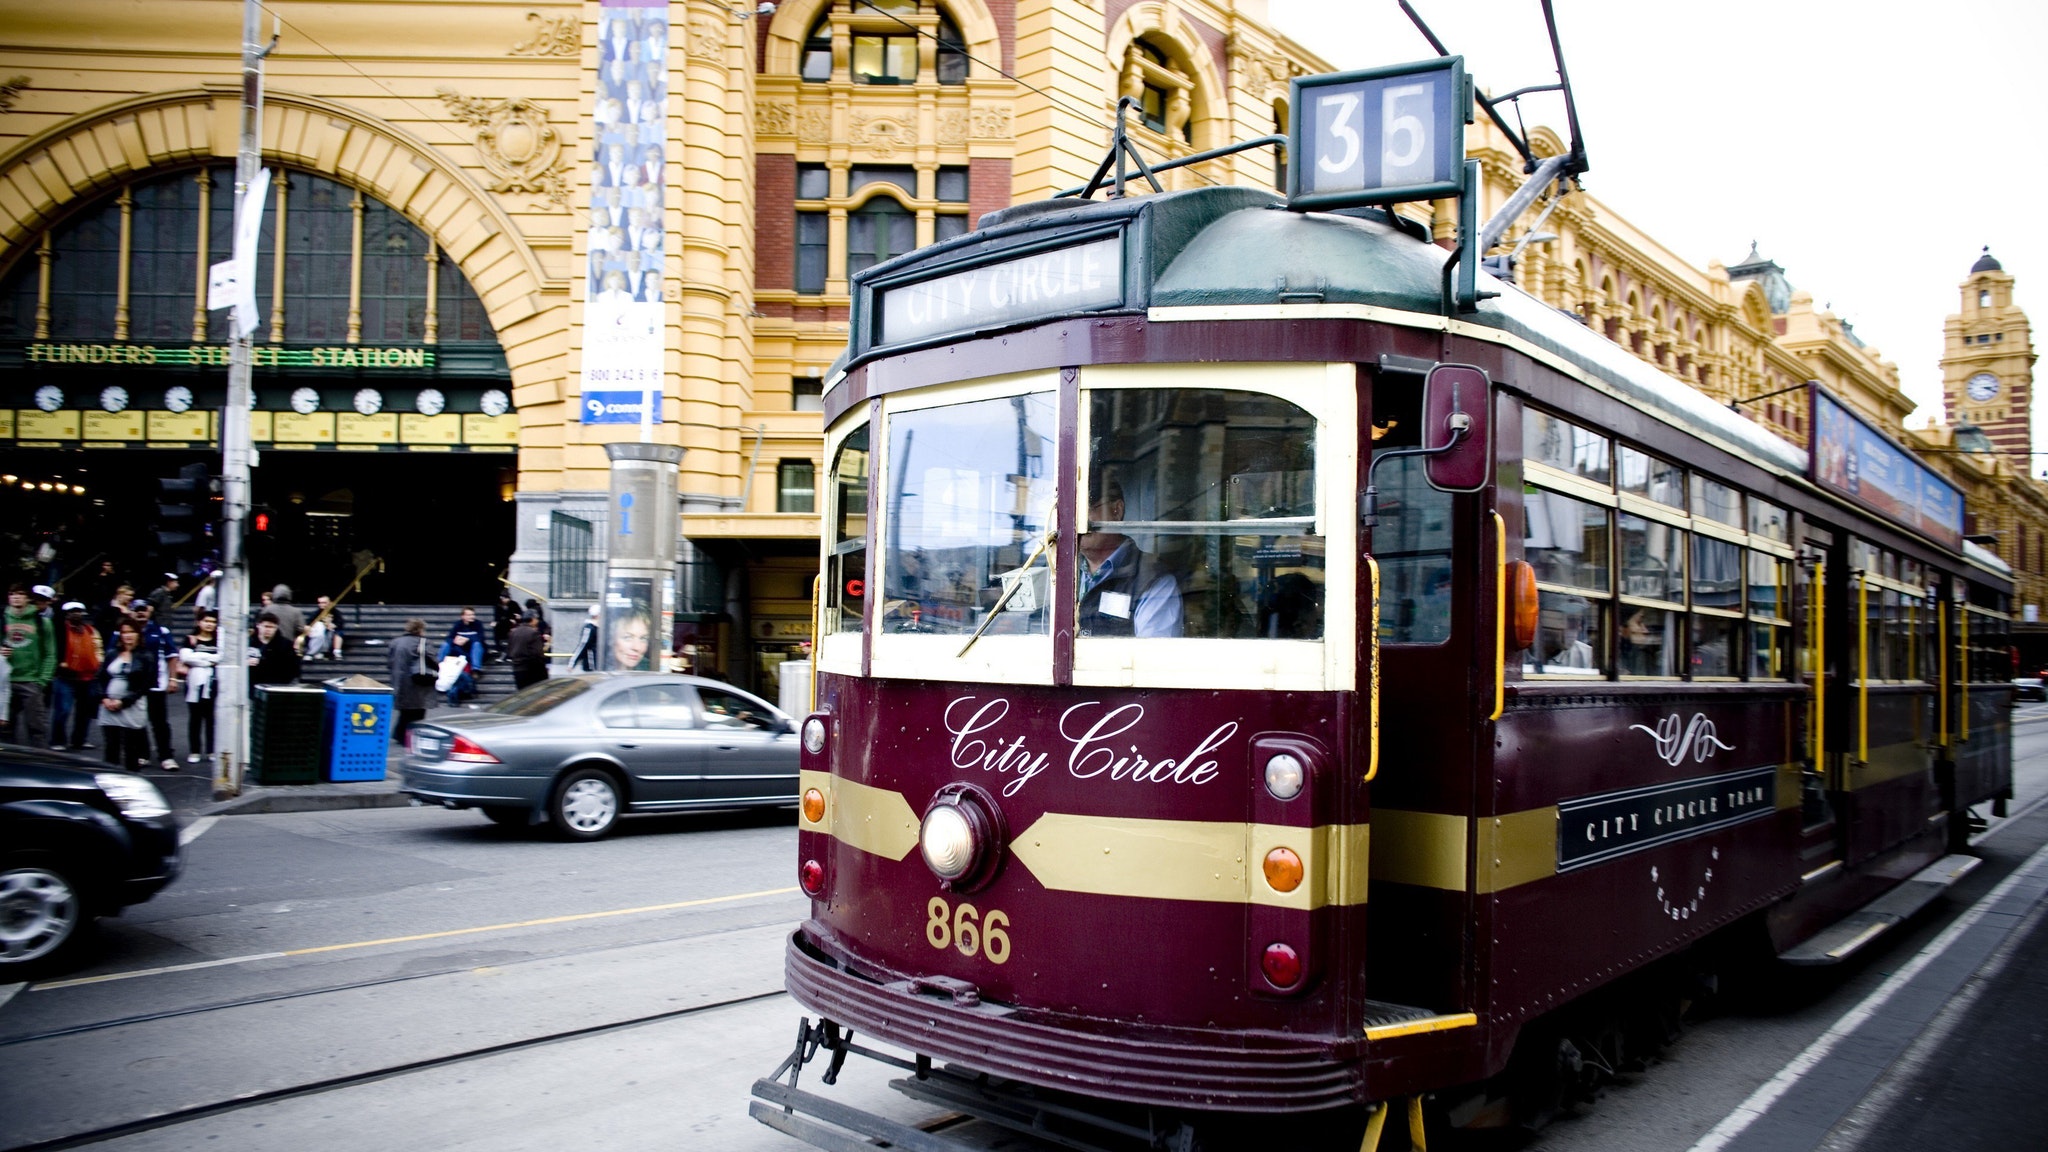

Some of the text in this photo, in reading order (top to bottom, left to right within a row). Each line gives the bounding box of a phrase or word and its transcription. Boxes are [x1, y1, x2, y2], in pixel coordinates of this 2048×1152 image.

[1317, 85, 1426, 174] 35
[907, 246, 1101, 325] CITY CIRCLE
[31, 343, 425, 368] FLINDERS STRET STATION
[944, 696, 1238, 798] City Circle
[1586, 786, 1763, 842] CITY CIRCLE TRAM
[925, 896, 1012, 965] 866
